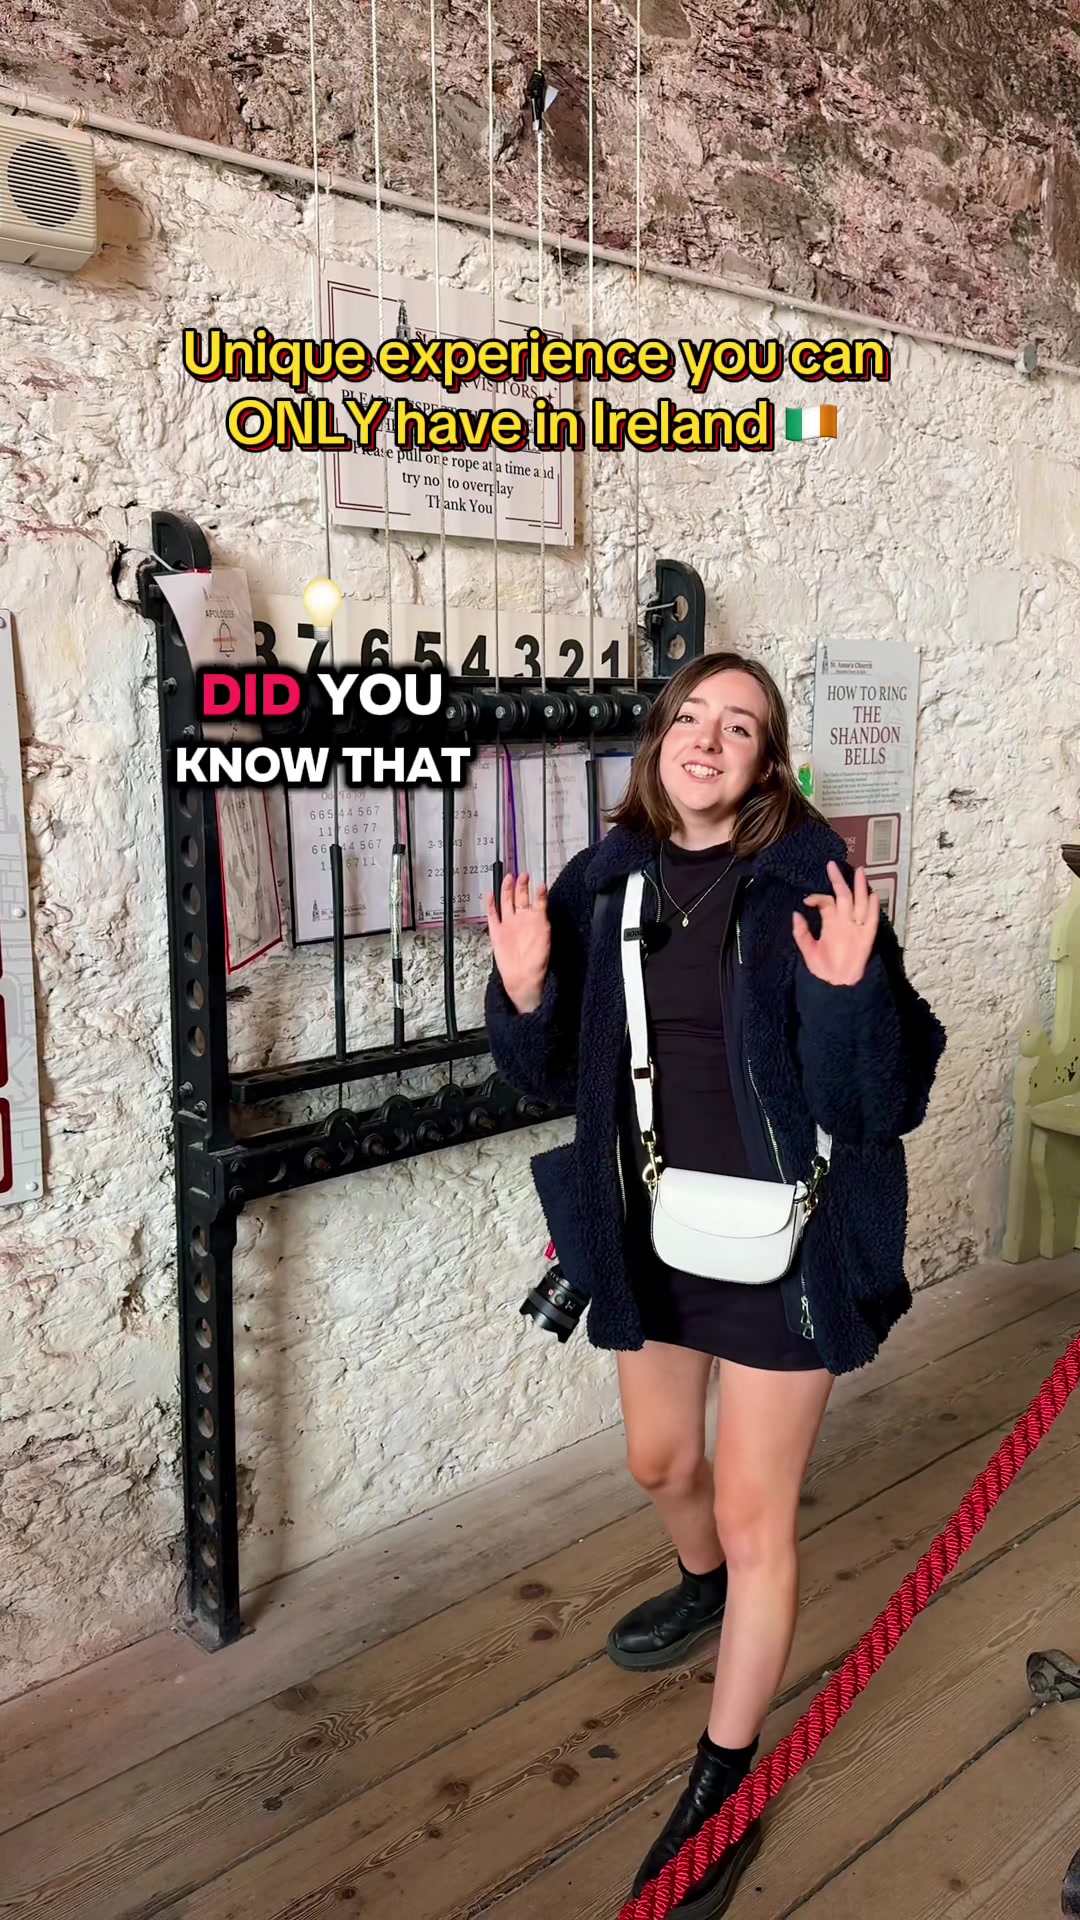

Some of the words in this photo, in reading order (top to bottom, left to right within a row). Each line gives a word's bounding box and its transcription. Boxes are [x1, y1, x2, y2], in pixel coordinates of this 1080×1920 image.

[472, 376, 538, 399] VISITORS
[397, 447, 422, 464] pull
[425, 453, 448, 466] one
[452, 456, 480, 472] rope
[482, 459, 493, 472] at
[496, 463, 502, 473] a
[505, 461, 531, 477] time
[402, 471, 420, 488] try
[424, 475, 443, 487] no
[447, 477, 460, 489] to
[462, 480, 514, 498] overplay
[469, 499, 493, 514] You
[298, 623, 331, 672] 7
[361, 628, 389, 668] 6
[413, 631, 443, 668] 5
[461, 635, 490, 676] 4
[514, 635, 541, 677] 3
[558, 639, 584, 677] 2
[601, 640, 620, 677] 1
[827, 685, 858, 701] HOW
[859, 685, 877, 701] TO
[879, 685, 908, 701] RING
[852, 705, 881, 723] THE
[830, 726, 901, 745] SHANDON
[844, 747, 886, 765] BELLS
[320, 791, 334, 801] Od
